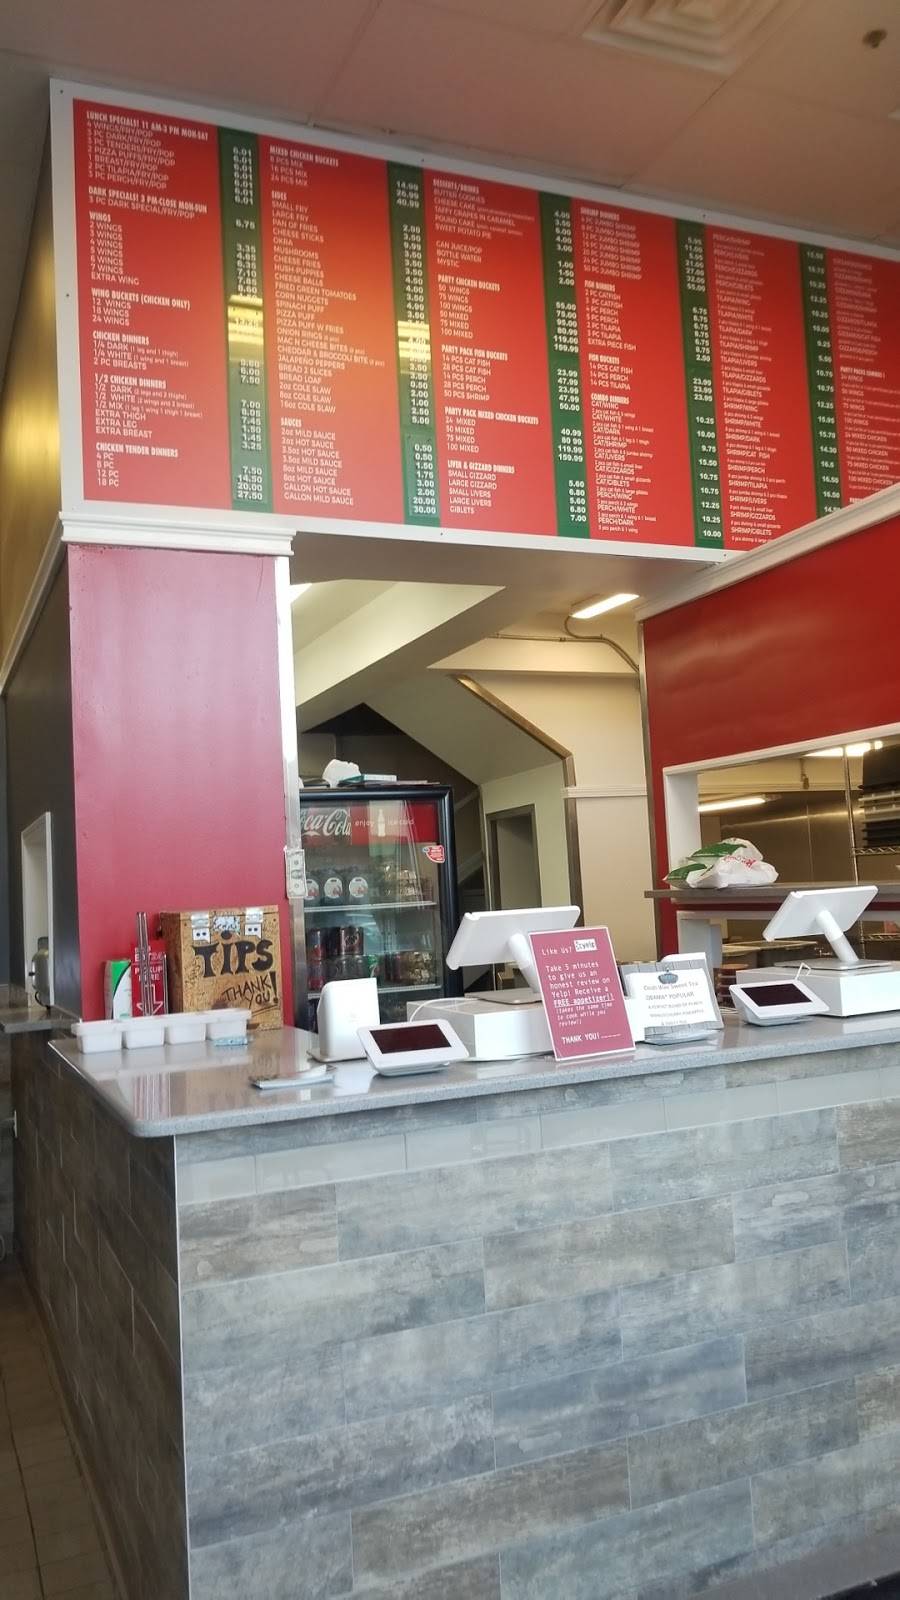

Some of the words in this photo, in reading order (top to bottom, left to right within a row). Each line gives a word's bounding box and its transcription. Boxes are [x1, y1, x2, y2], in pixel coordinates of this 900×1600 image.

[86, 110, 107, 122] LUNCH
[89, 211, 110, 222] WINGS
[91, 271, 116, 282] EXTRA
[118, 275, 139, 286] WING
[437, 274, 454, 284] PARTY
[456, 277, 477, 288] CHICKEN
[478, 281, 500, 291] BUCKETS
[275, 281, 294, 292] FRIED
[296, 284, 320, 295] GREEN
[322, 288, 356, 301] TOMATOES
[91, 287, 109, 298] WING
[111, 290, 138, 302] BUCKETS
[141, 294, 169, 307] (CHICKEN
[171, 299, 190, 310] ONLY)
[276, 308, 296, 318] PIZZA
[297, 311, 314, 320] PUFF
[103, 316, 129, 326] WINGS
[92, 330, 120, 341] CHICKEN
[122, 334, 148, 345] DINNERS
[588, 338, 605, 346] EXTRA
[607, 340, 622, 349] PIECE
[624, 343, 636, 351] FISH
[441, 344, 458, 354] PARTY
[459, 347, 472, 356] PACK
[486, 350, 507, 360] BUCKETS
[112, 359, 146, 370] BREASTS
[315, 359, 345, 369] PEPPERS
[110, 374, 137, 386] CHICKEN
[138, 378, 166, 389] DINNERS
[278, 372, 302, 382] BREAD
[304, 375, 321, 384] LOAF
[292, 383, 310, 392] COLE
[312, 386, 331, 394] SLAW
[410, 389, 428, 398] 2.00
[411, 398, 428, 407] 1.00
[95, 408, 120, 418] EXTRA
[122, 411, 146, 421] THIGH
[412, 416, 429, 424] 5.00
[96, 417, 120, 426] EXTRA
[280, 417, 301, 427] SAUCES
[96, 426, 120, 435] EXTRA
[123, 428, 152, 438] BREAST
[295, 429, 311, 437] MILD
[313, 431, 335, 440] SAUCE
[96, 442, 123, 453] CHICKEN
[125, 445, 149, 455] TENDER
[151, 447, 177, 458] DINNERS
[414, 443, 432, 452] 0.50
[447, 460, 461, 468] LIVER
[468, 462, 491, 471] GIZZARD
[493, 464, 514, 473] DINNERS
[448, 469, 468, 478] SMALL
[469, 471, 496, 480] GIZZARD
[237, 482, 262, 491] 20.00
[283, 482, 311, 492] GALLON
[328, 486, 350, 495] SAUCE
[416, 479, 434, 487] 3.00
[448, 478, 468, 487] LARGE
[469, 480, 496, 490] GIZZARD
[448, 487, 468, 496] SMALL
[470, 489, 490, 498] LIVERS
[284, 492, 311, 501] GALLON
[313, 494, 329, 503] MILD
[331, 496, 353, 505] SAUCE
[413, 496, 435, 505] 20.00
[449, 496, 469, 504] LARGE
[471, 498, 491, 506] LIVERS
[414, 505, 435, 514] 30.00
[449, 505, 474, 514] GIBLETS
[570, 514, 586, 522] 7.00
[573, 962, 599, 970] minutes
[560, 972, 575, 981] give
[221, 974, 272, 1002] THANK
[550, 981, 573, 990] honest
[577, 978, 599, 986] review
[575, 987, 601, 995] Receive
[554, 999, 569, 1007] FREE
[562, 1035, 582, 1044] THANK
